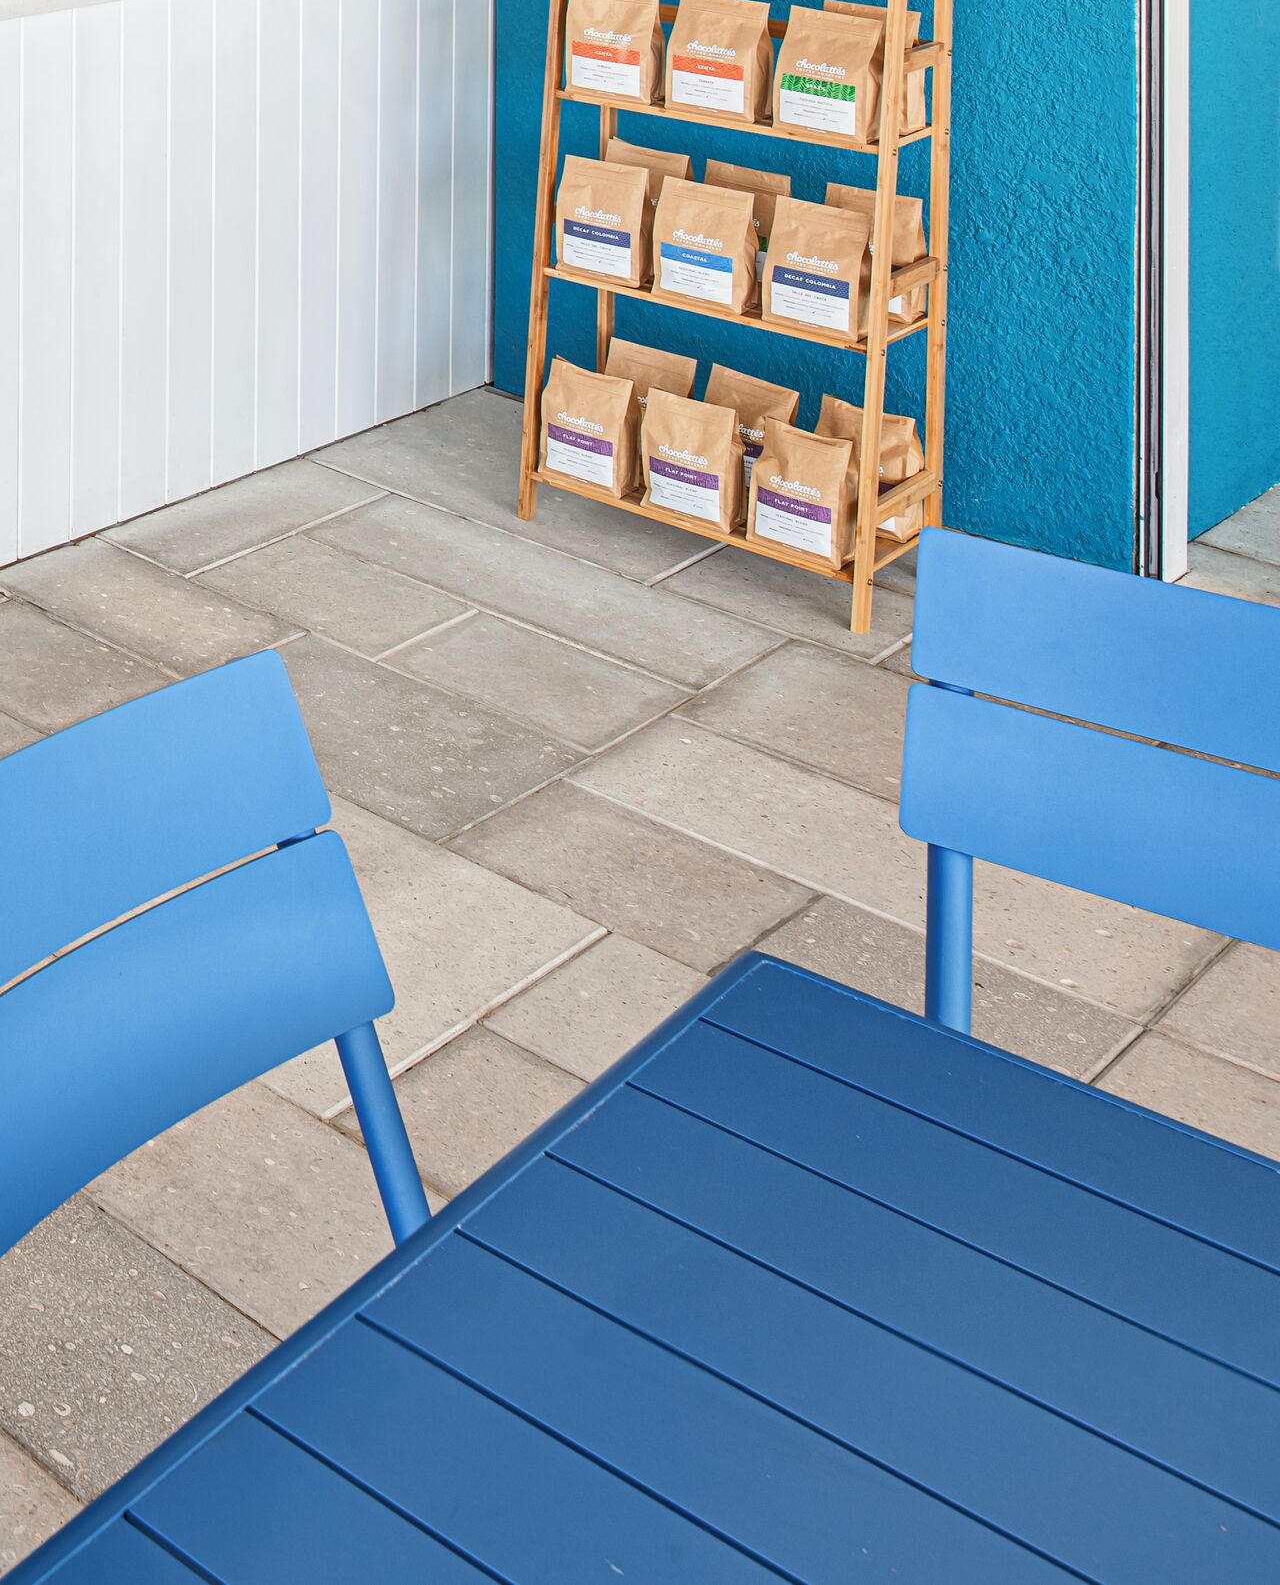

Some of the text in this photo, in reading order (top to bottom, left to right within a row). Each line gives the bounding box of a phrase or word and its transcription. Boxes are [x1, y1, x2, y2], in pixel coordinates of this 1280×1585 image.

[591, 230, 620, 240] COLOMBIA
[682, 253, 708, 263] COASTAL
[665, 467, 698, 480] FLAT POINT
